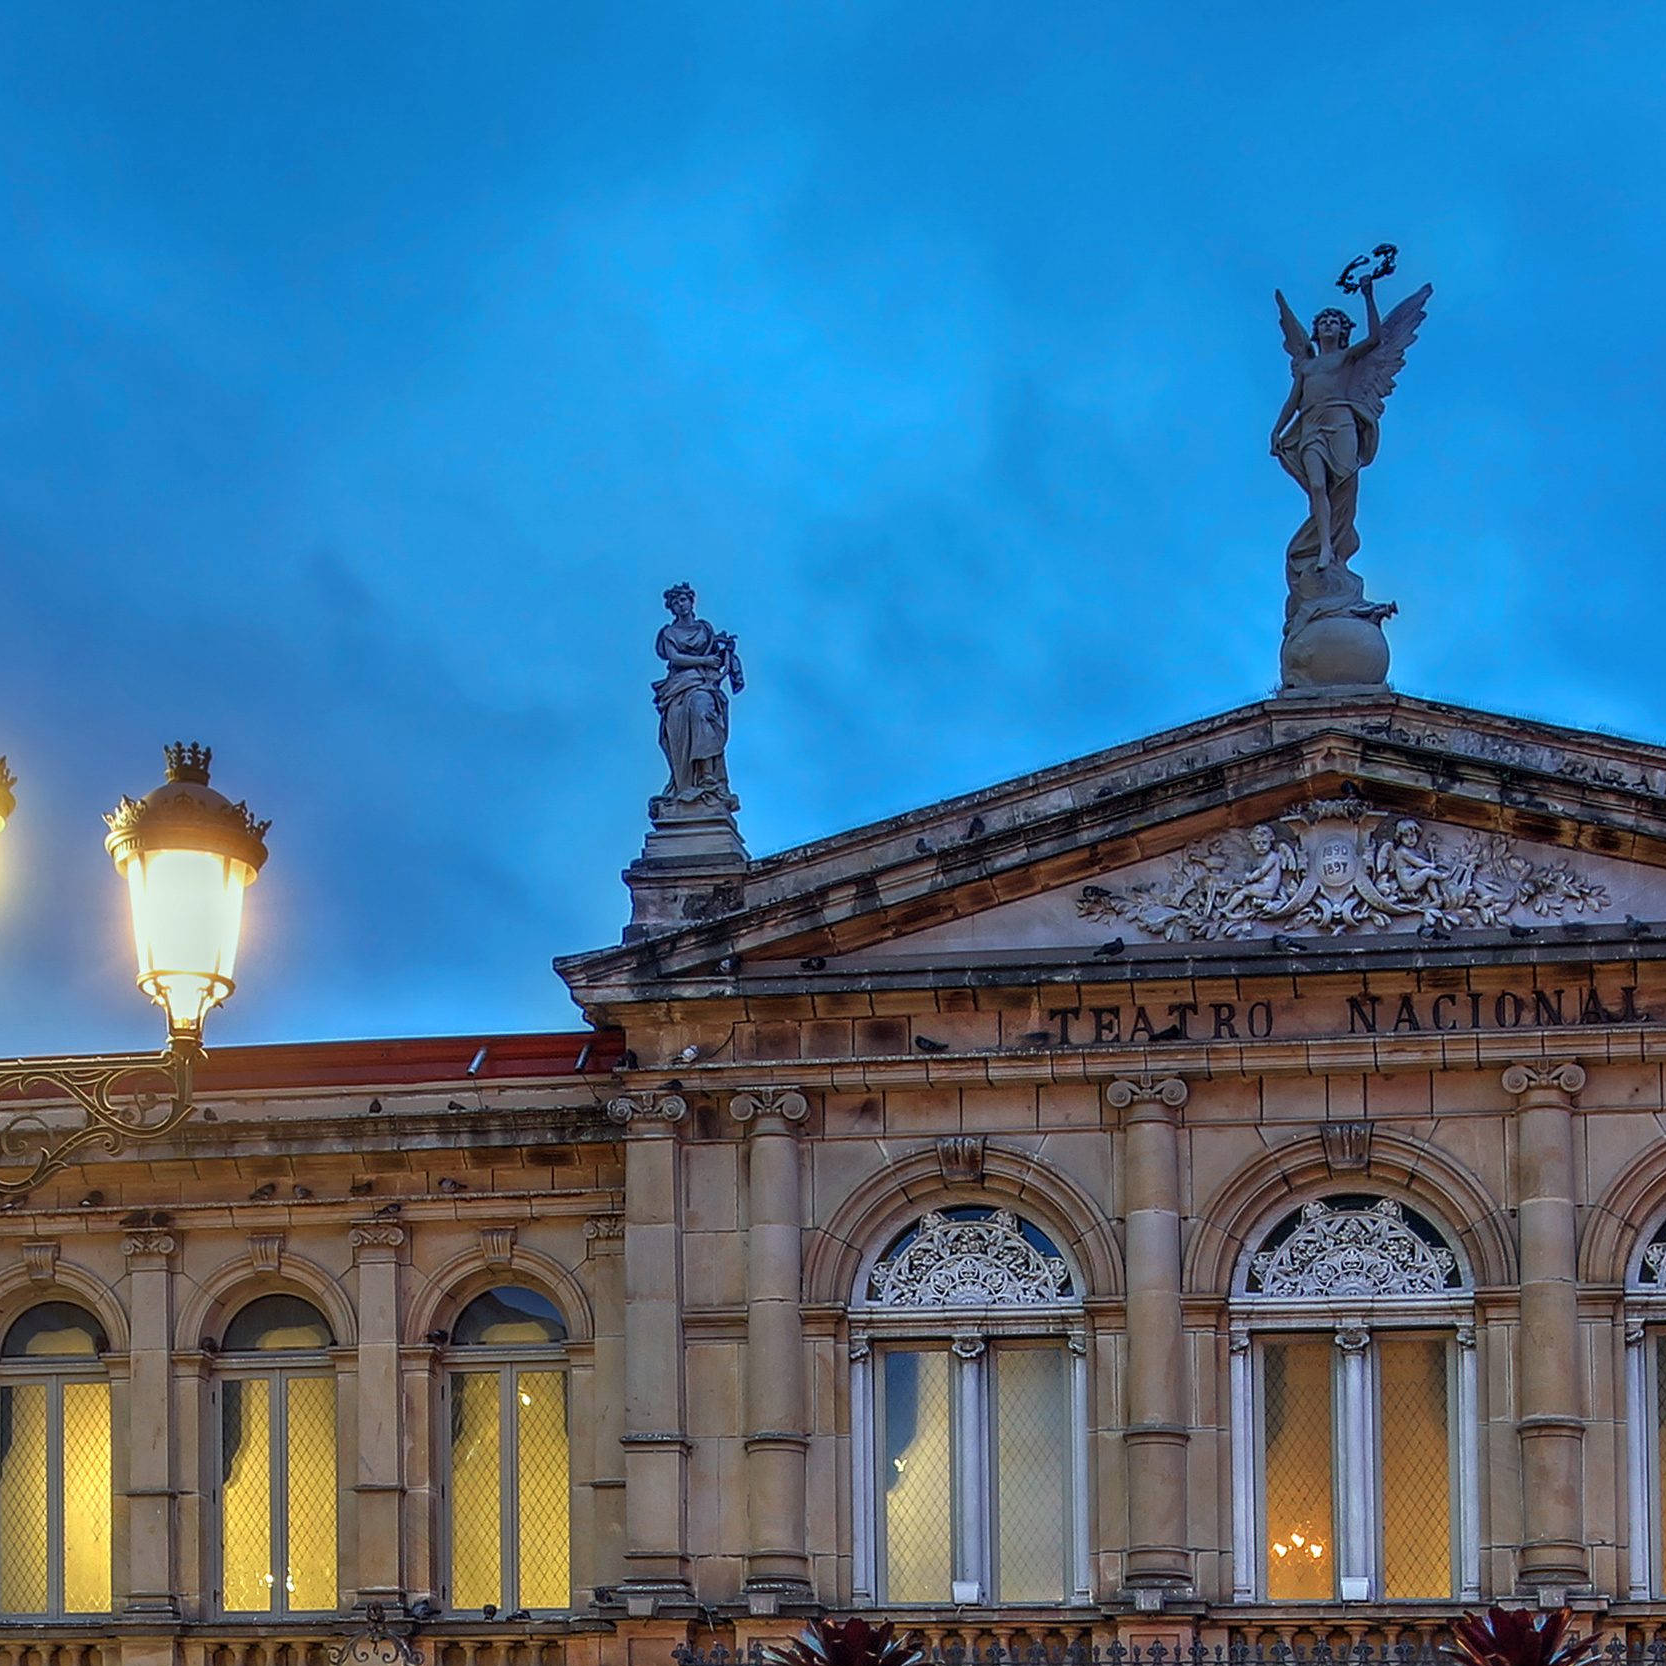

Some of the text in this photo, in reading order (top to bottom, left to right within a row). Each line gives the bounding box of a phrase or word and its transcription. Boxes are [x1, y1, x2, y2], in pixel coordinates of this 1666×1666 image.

[1322, 844, 1349, 858] 1890
[1322, 861, 1349, 876] 1897
[1048, 986, 1650, 1055] TEATRO NACIONAL
